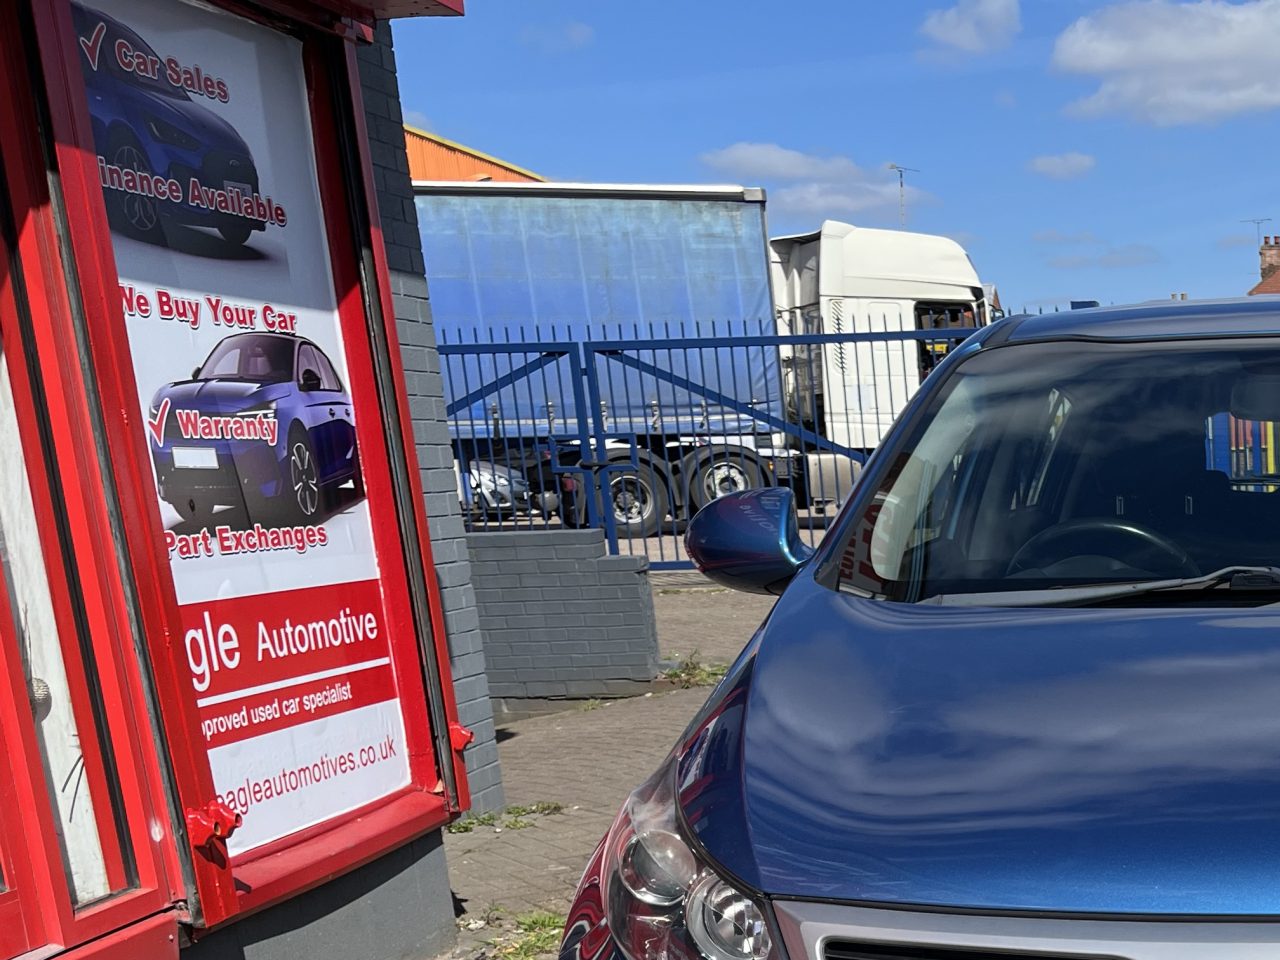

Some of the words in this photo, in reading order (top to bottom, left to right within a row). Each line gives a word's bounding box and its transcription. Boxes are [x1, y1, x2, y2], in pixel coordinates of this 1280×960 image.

[114, 38, 159, 80] Car
[166, 58, 230, 103] Sales
[97, 155, 183, 203] inance
[188, 178, 288, 226] Available
[156, 288, 200, 329] Buy
[205, 294, 256, 330] Your
[262, 303, 297, 333] Car
[177, 410, 278, 445] Warranty
[164, 526, 214, 559] Part
[216, 523, 329, 554] Exchanges
[184, 610, 241, 692] gle
[257, 607, 378, 662] Automotive
[202, 706, 249, 741] proved
[250, 698, 281, 725] used
[282, 697, 300, 715] car
[303, 681, 353, 713] specialist
